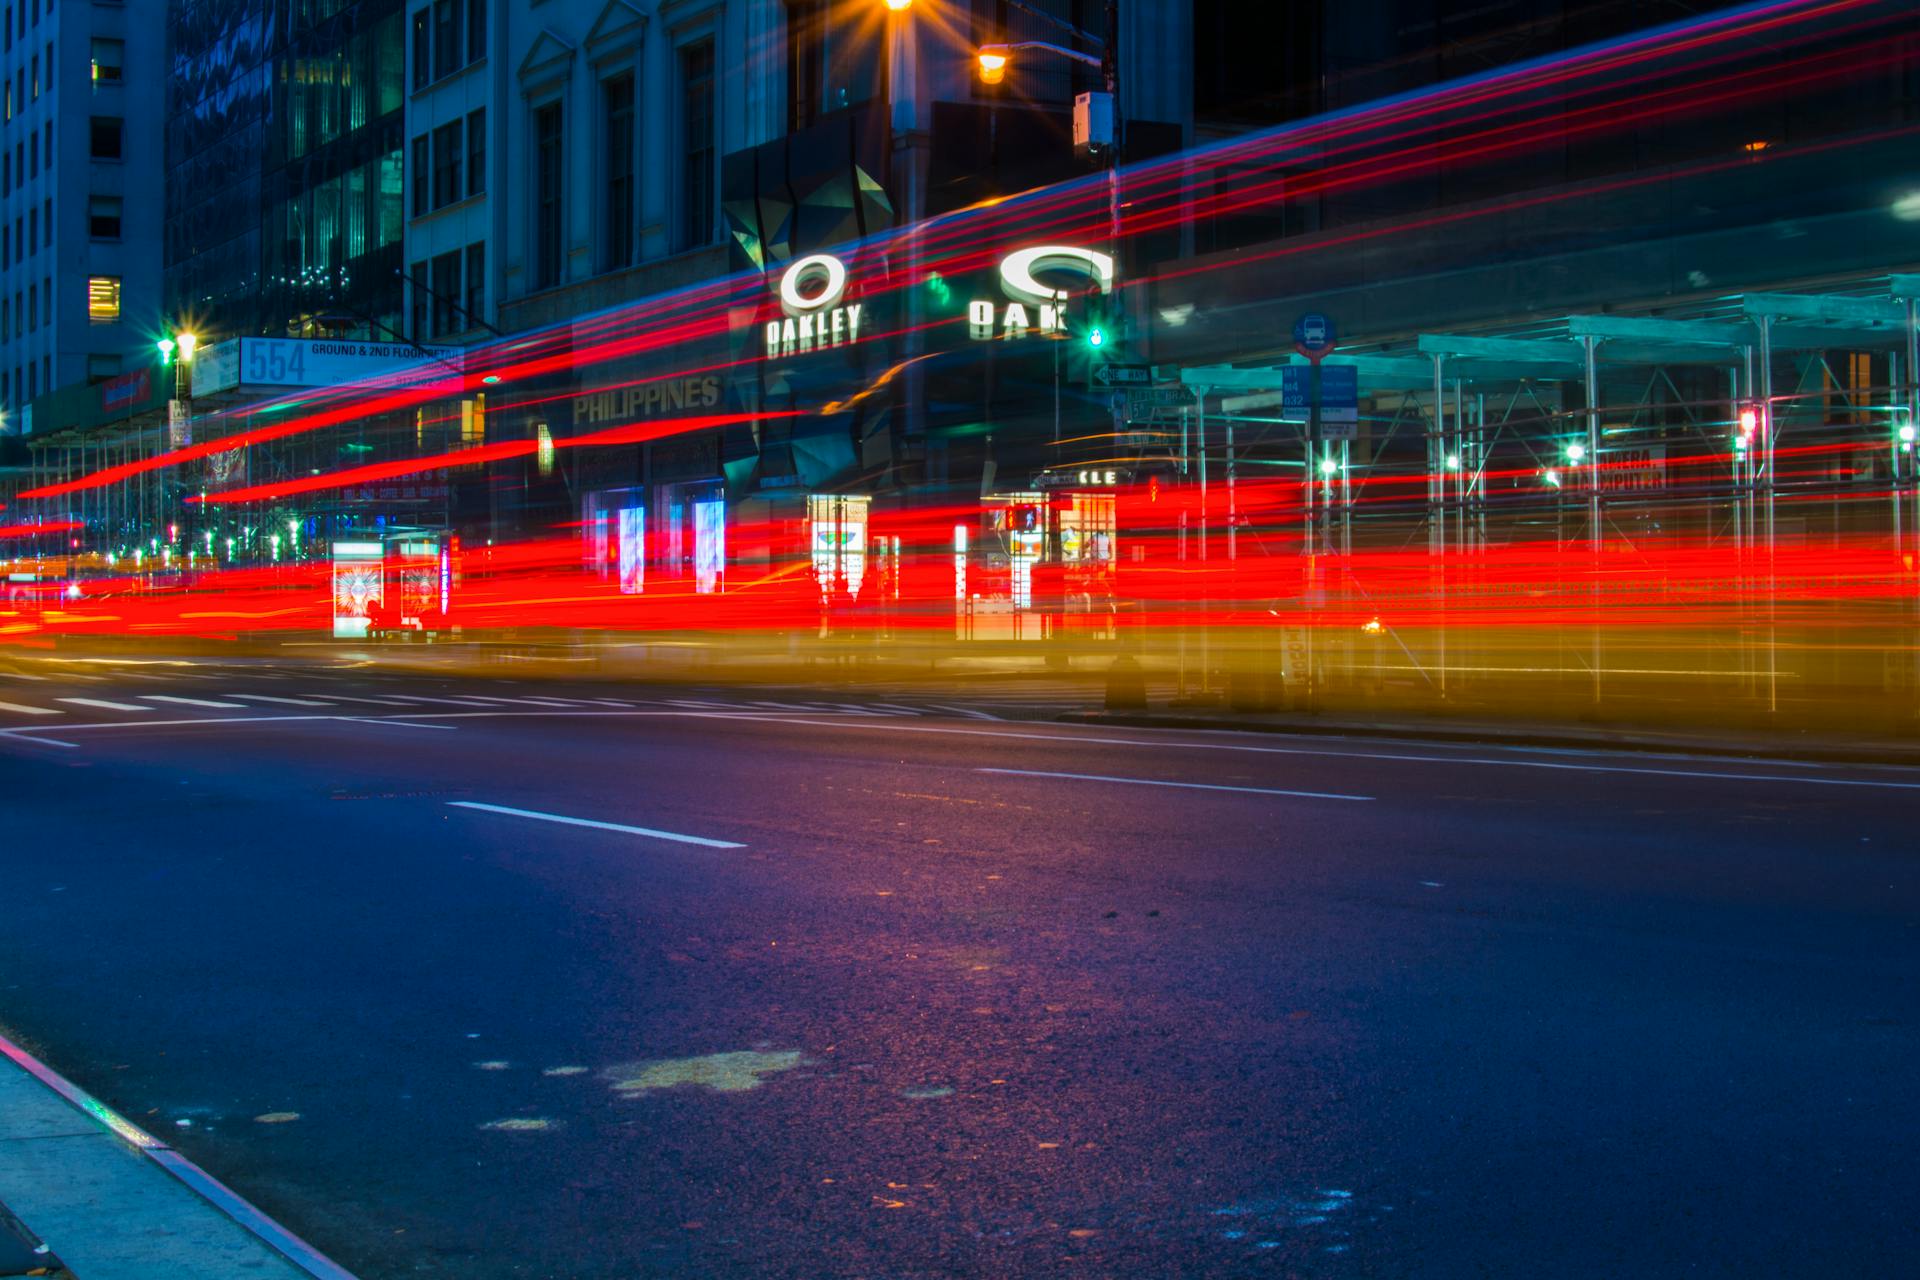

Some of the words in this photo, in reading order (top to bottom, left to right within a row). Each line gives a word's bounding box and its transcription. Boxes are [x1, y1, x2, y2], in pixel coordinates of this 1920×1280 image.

[767, 304, 861, 348] OAKLEY
[969, 300, 1068, 331] OAK
[250, 341, 305, 382] 554
[312, 343, 356, 356] GROUND
[358, 345, 367, 357] &
[369, 345, 390, 358] 2ND
[392, 346, 425, 360] FLOOR
[1101, 368, 1119, 380] ONE
[1128, 368, 1145, 380] WAY
[574, 376, 719, 424] PHILIPPINES
[1599, 448, 1657, 471] AMERA,
[1079, 470, 1117, 485] KLE
[1580, 471, 1662, 491] MPUTER
